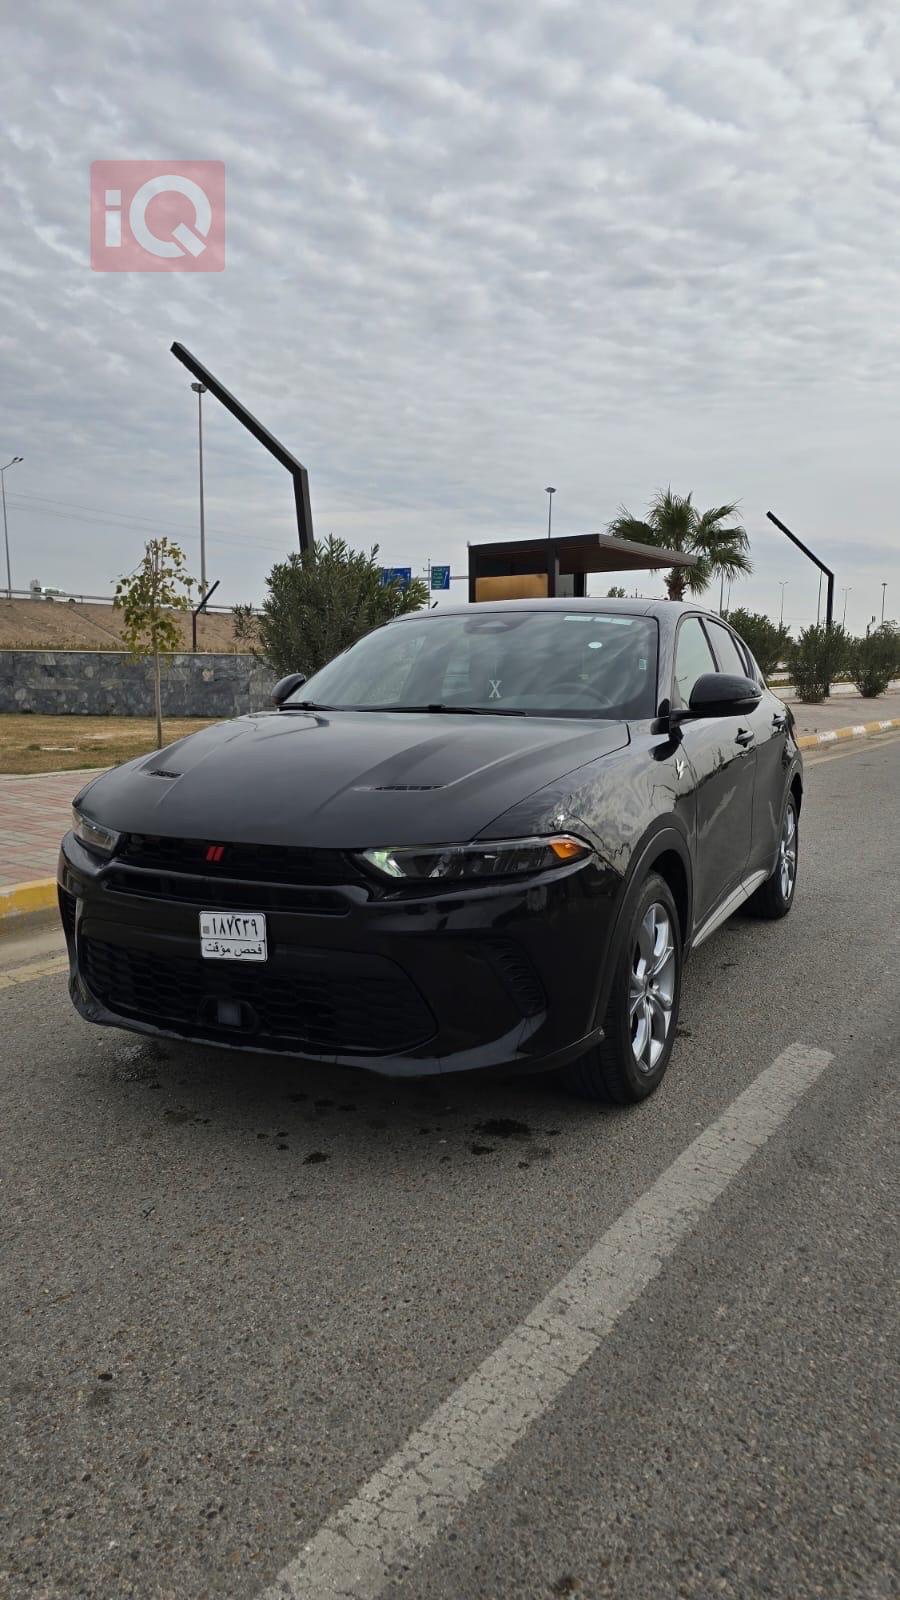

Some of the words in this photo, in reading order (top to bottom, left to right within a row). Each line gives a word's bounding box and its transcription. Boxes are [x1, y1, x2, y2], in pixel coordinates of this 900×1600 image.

[489, 680, 502, 698] X
[213, 917, 258, 936] ١٨٧٢٣٩
[234, 943, 262, 957] فحص
